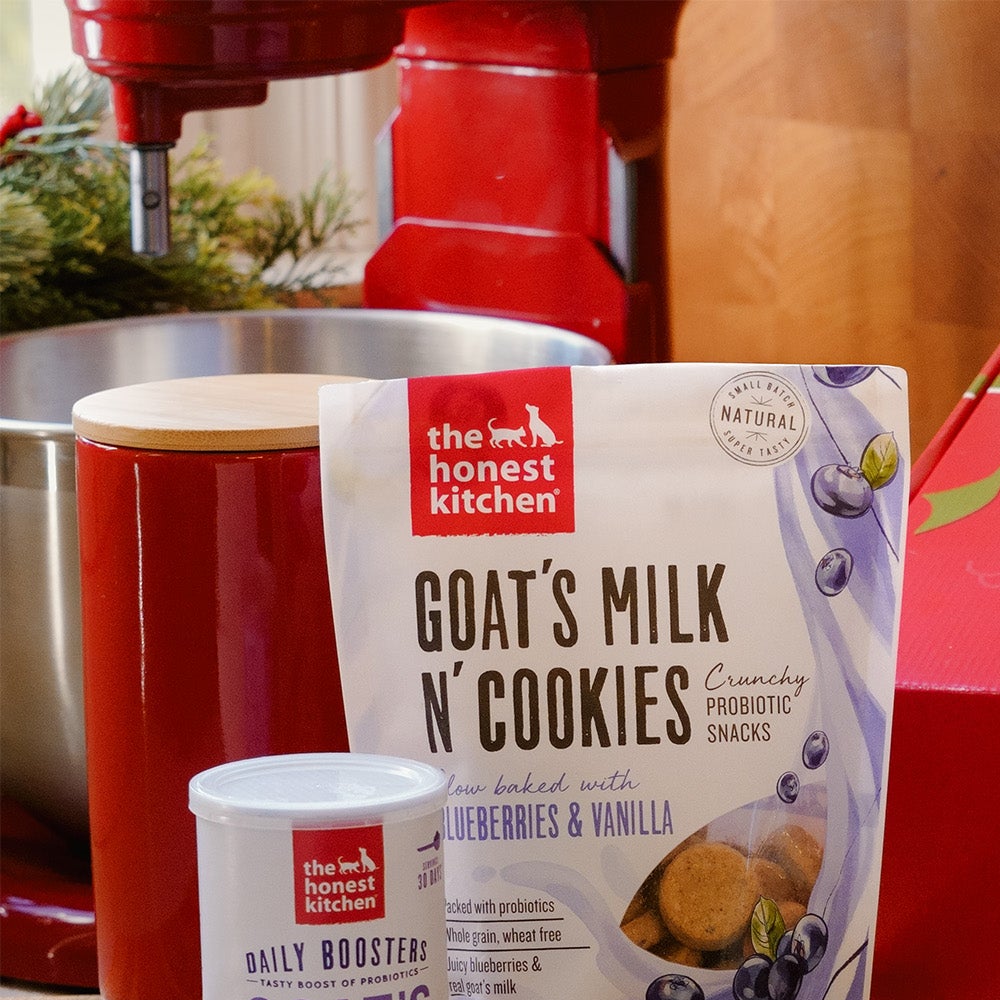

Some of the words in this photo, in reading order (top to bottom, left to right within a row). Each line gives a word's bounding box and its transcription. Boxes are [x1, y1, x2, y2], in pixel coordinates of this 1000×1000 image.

[728, 380, 761, 399] SMALL
[766, 382, 796, 408] BATCH
[721, 405, 797, 431] NATURAL
[427, 423, 483, 450] the
[723, 430, 753, 455] SUPER
[759, 437, 791, 456] TASTY
[429, 454, 555, 483] honest
[415, 559, 577, 653] GOAT'S
[602, 563, 729, 647] MILK
[705, 662, 810, 697] Crunchy
[477, 664, 692, 752] COOKIES
[706, 695, 791, 716] PROBIOTIC
[707, 722, 771, 743] SNACKS
[442, 769, 487, 797] low
[494, 772, 570, 796] baked
[580, 768, 640, 792] with
[567, 802, 583, 837] &
[591, 800, 674, 837] VANILLA
[303, 859, 336, 876] the
[304, 876, 376, 895] honest
[305, 895, 376, 913] kitchen
[445, 898, 472, 914] acked
[475, 899, 496, 914] with
[499, 898, 555, 917] probiotics
[472, 928, 500, 946] grain,
[502, 928, 536, 943] wheat
[539, 927, 562, 942] free
[245, 942, 305, 974] DAILY
[322, 937, 427, 970] BOOSTERS
[447, 957, 468, 975] Juicy
[470, 957, 528, 973] blueberries
[532, 955, 542, 971] &
[260, 979, 293, 988] TASTY
[298, 980, 336, 989] BOOST
[341, 979, 356, 988] OF
[360, 968, 419, 985] PROBIOTICS
[449, 979, 465, 993] real
[466, 979, 491, 997] goat's
[493, 979, 517, 995] milk
